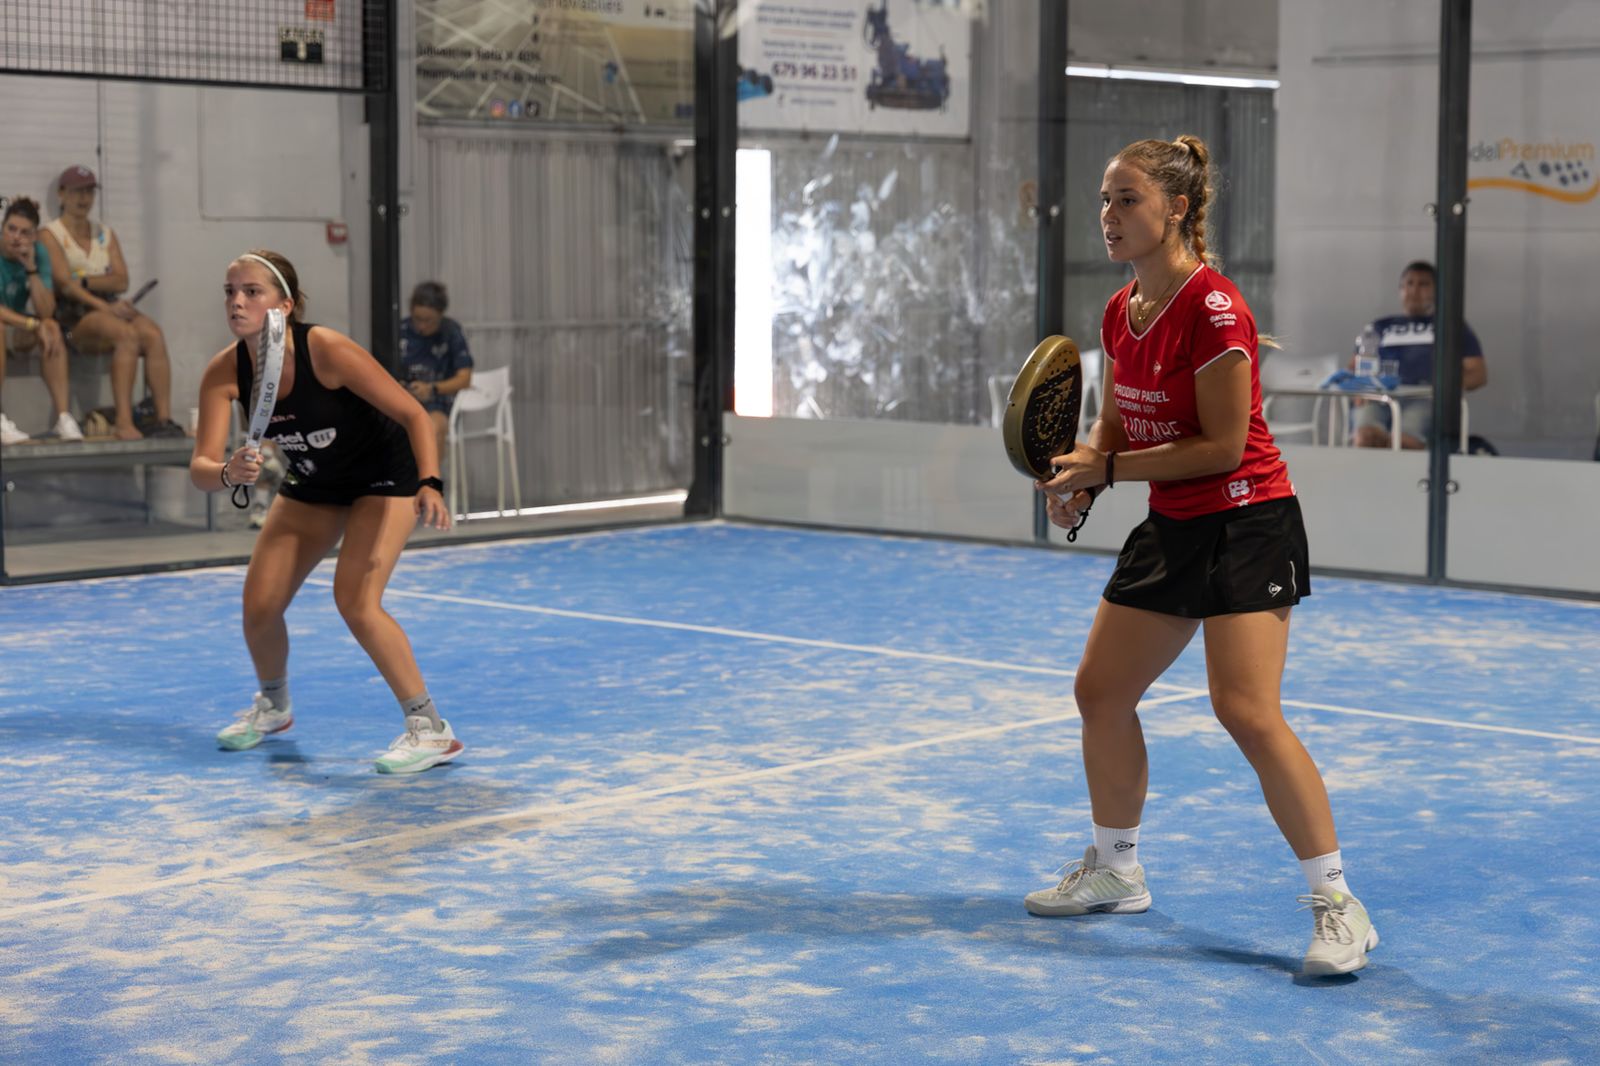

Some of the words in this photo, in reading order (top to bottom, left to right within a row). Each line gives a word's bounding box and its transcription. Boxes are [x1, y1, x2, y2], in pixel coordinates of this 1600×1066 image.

[1468, 137, 1595, 162] delPremium
[1114, 383, 1141, 400] PRODIGY
[1141, 390, 1170, 403] PADEL
[271, 431, 305, 444] del
